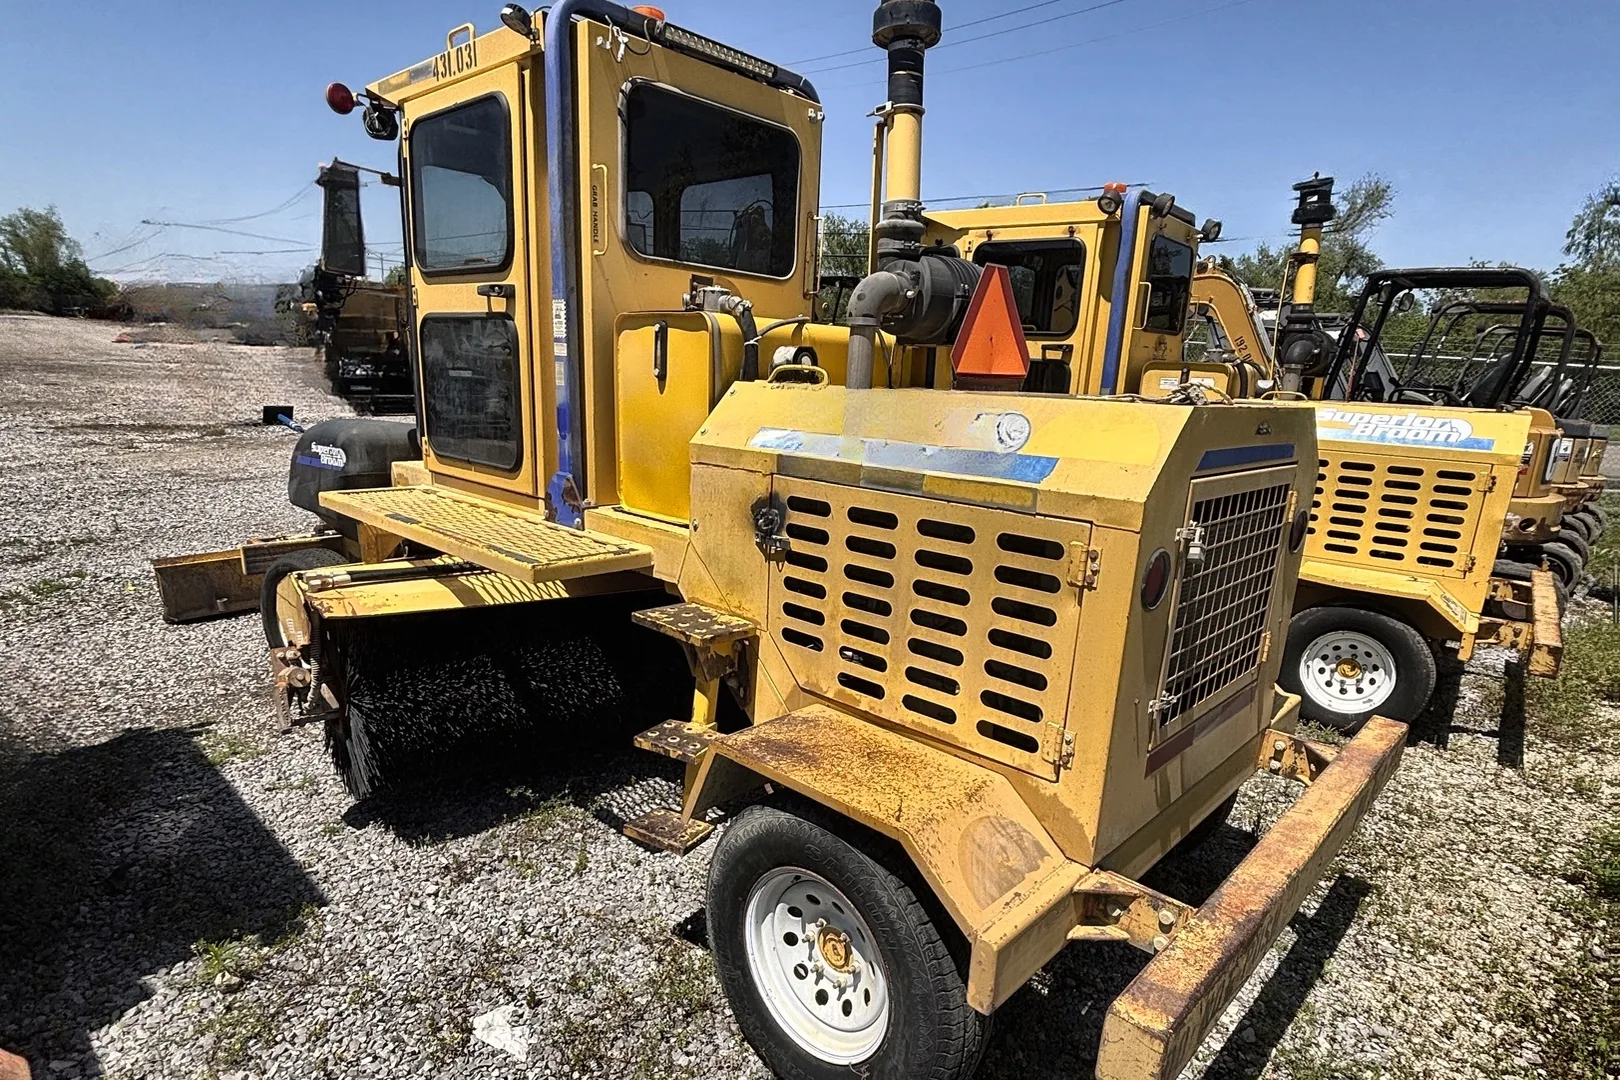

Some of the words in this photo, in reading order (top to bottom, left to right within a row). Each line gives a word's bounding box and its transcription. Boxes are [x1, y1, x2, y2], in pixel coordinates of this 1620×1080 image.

[432, 40, 477, 82] 431.031
[1317, 408, 1456, 431] Superior
[1350, 423, 1463, 443] Broom
